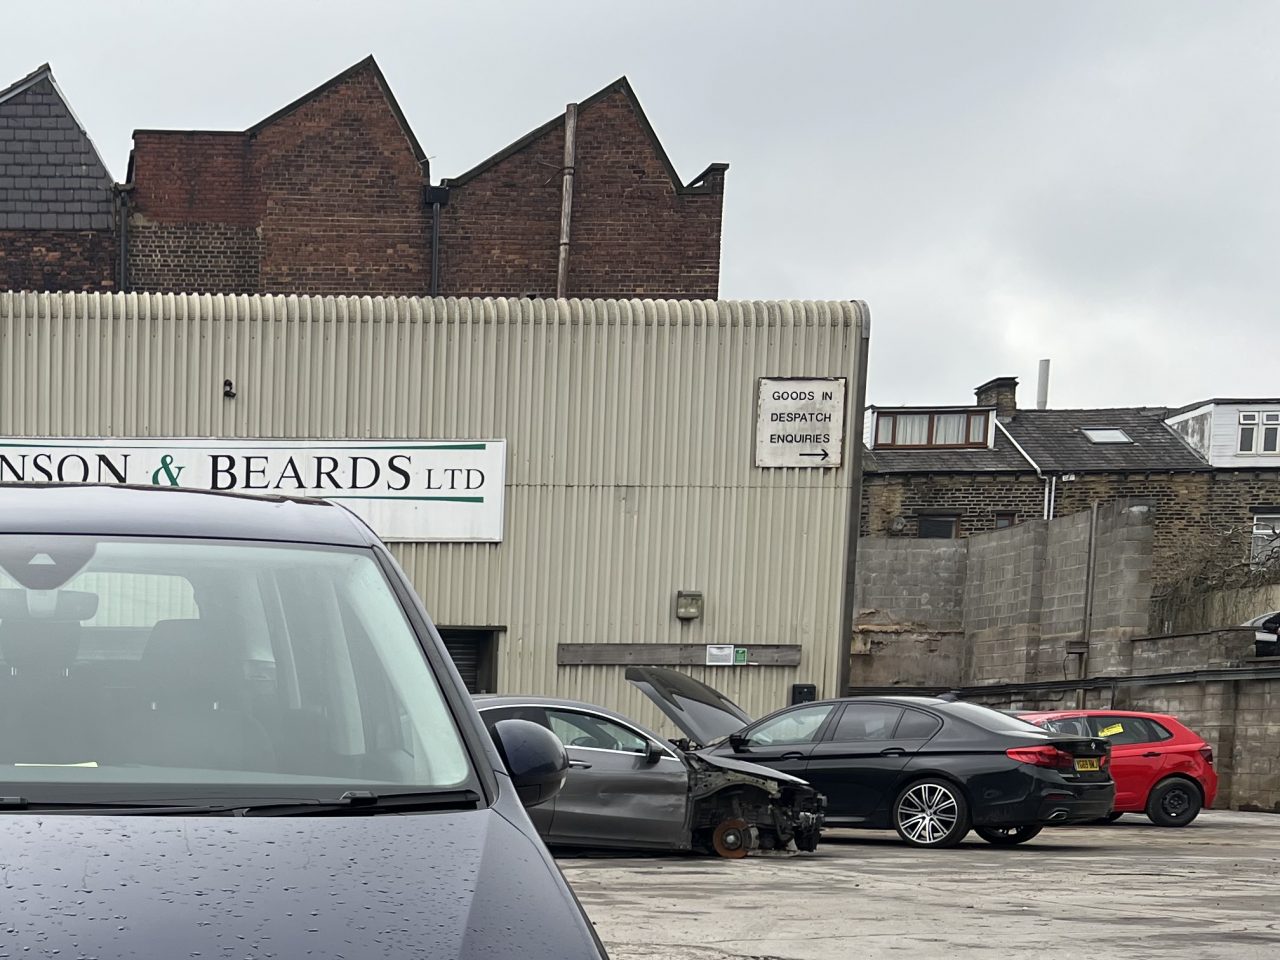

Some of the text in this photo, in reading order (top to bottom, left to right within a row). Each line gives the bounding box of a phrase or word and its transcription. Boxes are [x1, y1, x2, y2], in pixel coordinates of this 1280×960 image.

[772, 391, 833, 401] GOODS IN
[770, 412, 832, 423] DESPATCH
[769, 433, 830, 444] ENQUIRIES
[152, 454, 185, 486] &
[208, 454, 412, 491] BEARDS
[425, 468, 485, 490] LTD
